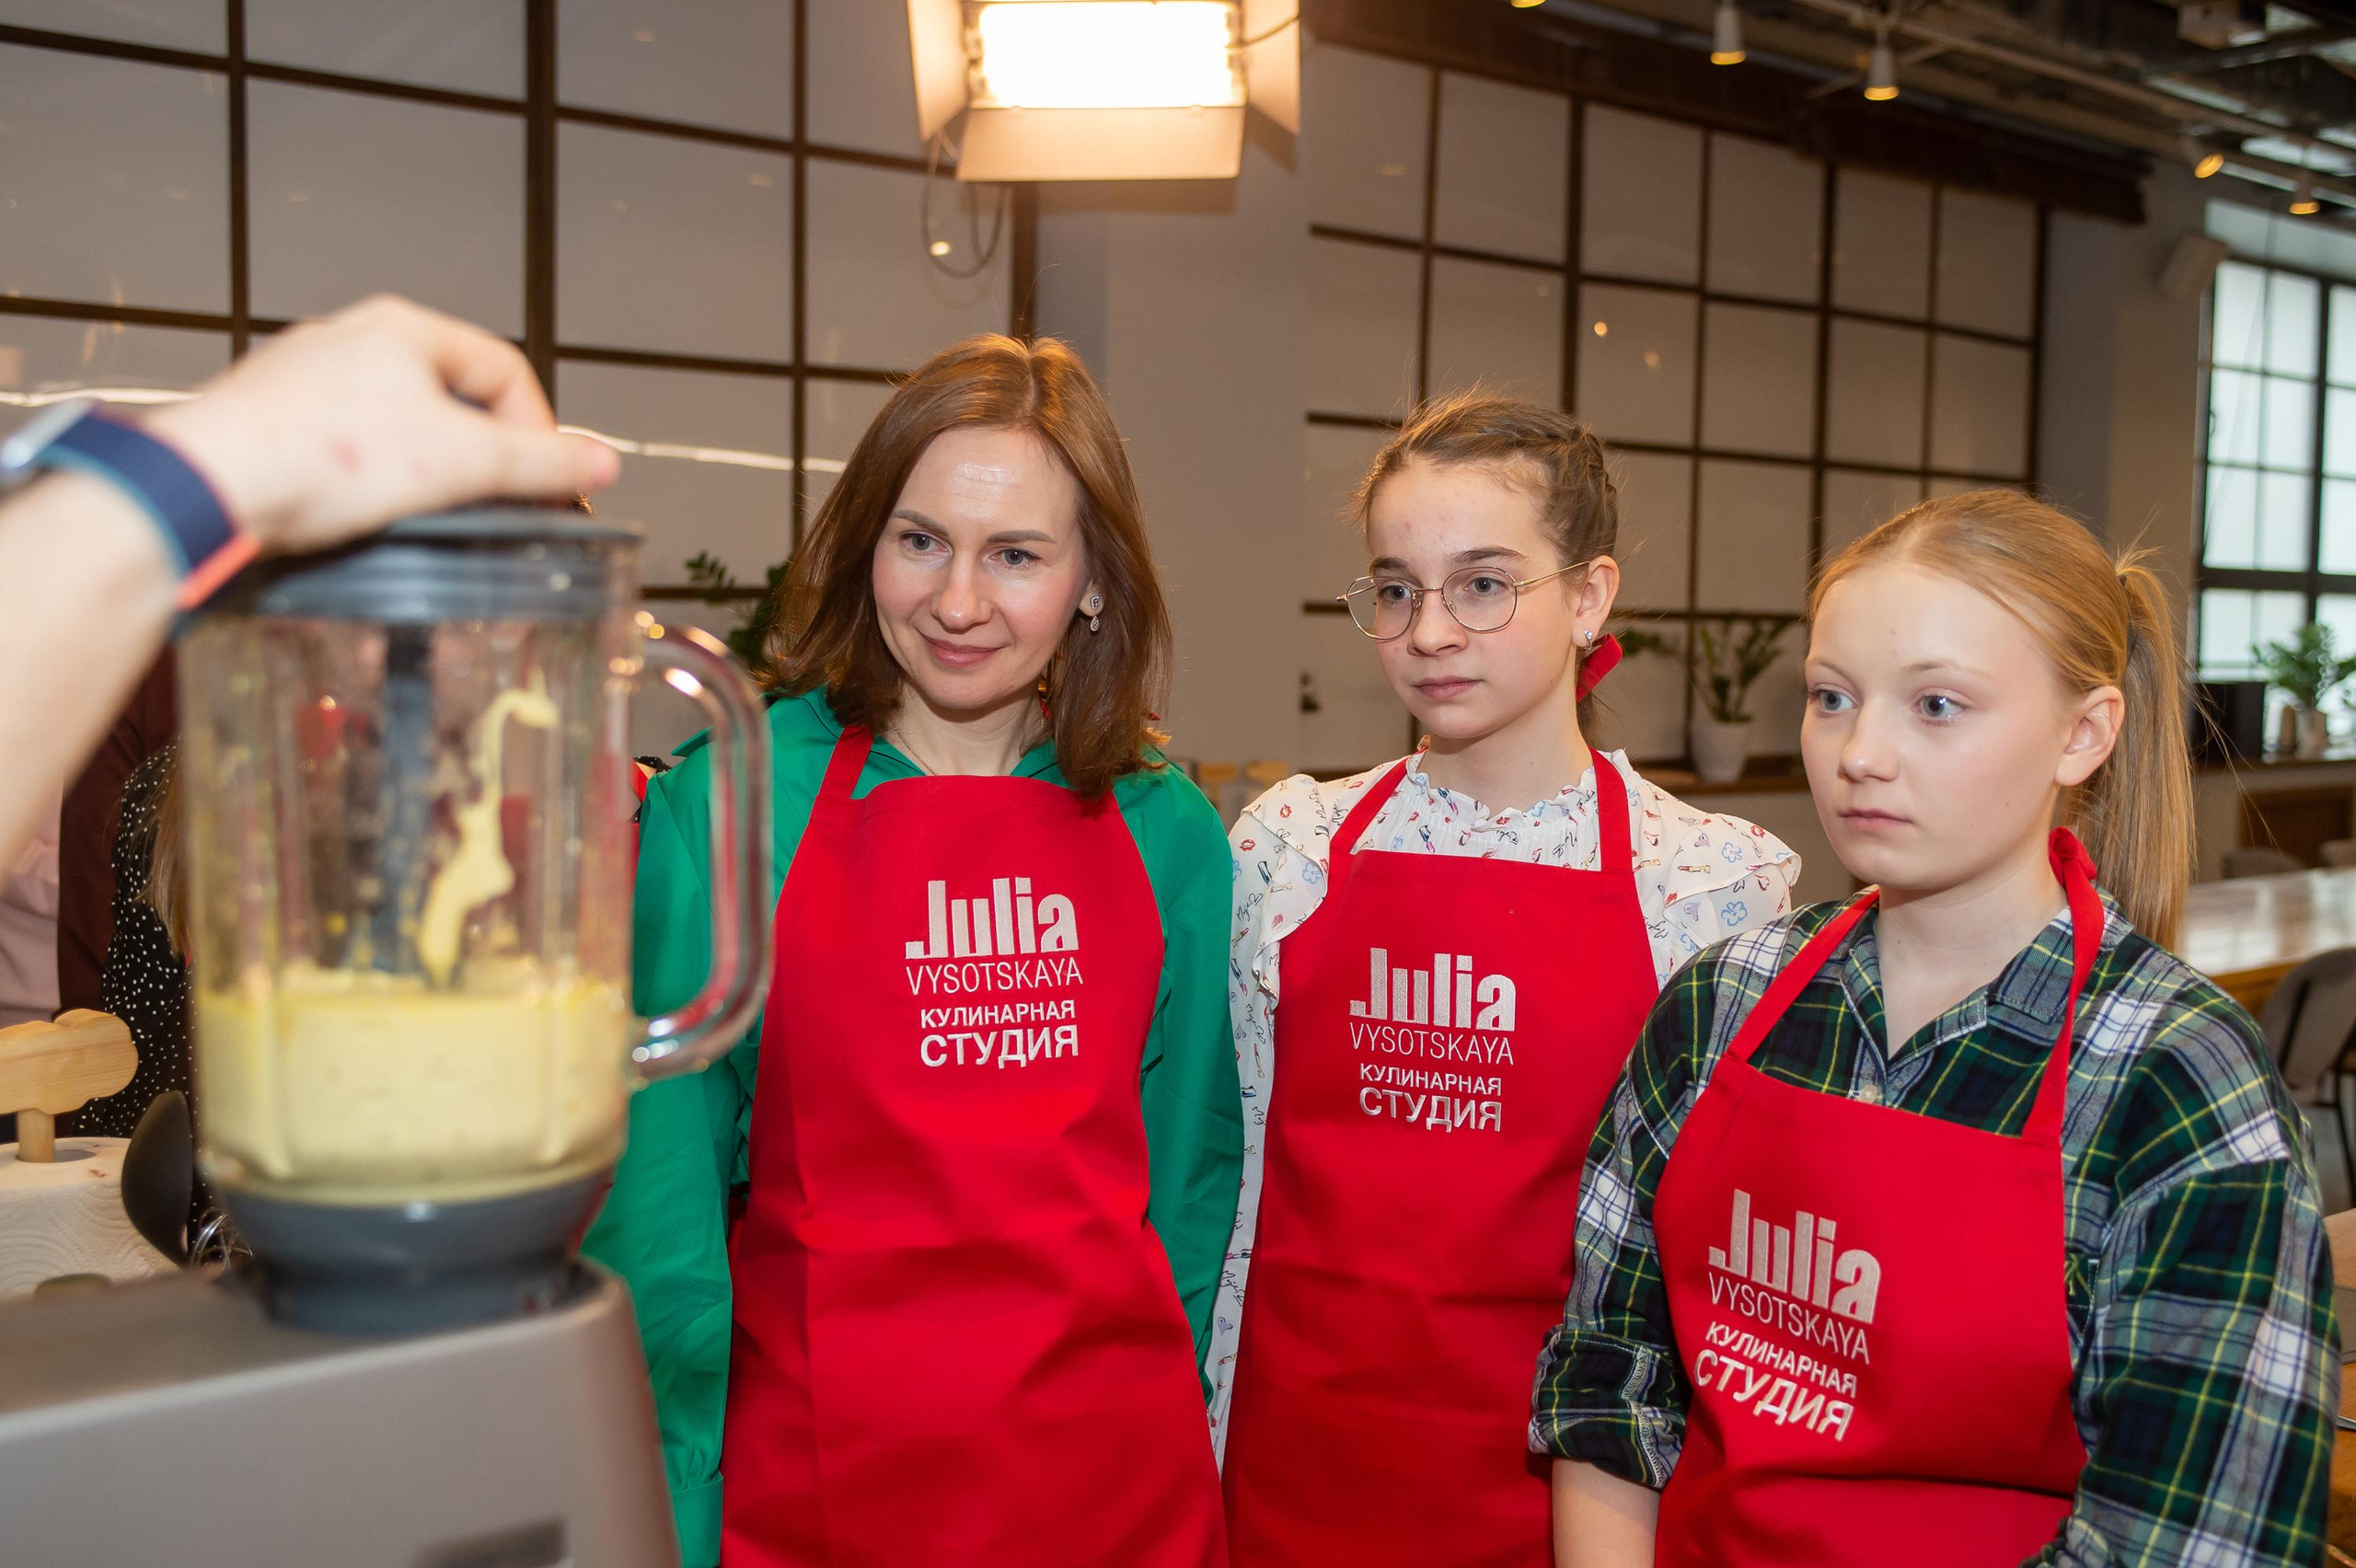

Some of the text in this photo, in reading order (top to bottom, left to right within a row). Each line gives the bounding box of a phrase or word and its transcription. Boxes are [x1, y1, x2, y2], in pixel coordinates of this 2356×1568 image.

[905, 876, 1080, 959] Julia
[906, 956, 1084, 996] VYSOTSKAYA
[1349, 947, 1517, 1032] Julia
[920, 999, 1076, 1029] КУЛИНАРНАЯ
[1349, 1021, 1514, 1066] VYSOTSKAYA
[920, 1024, 1079, 1069] СТУДИЯ
[1359, 1063, 1502, 1096] КУЛИНАРНАЯ
[1359, 1087, 1502, 1133] СТУДИЯ
[1708, 1188, 1881, 1325] Julia
[1708, 1272, 1870, 1365] VYSOTSKAYA
[1705, 1320, 1857, 1399] КУЛИНАРНАЯ
[1694, 1349, 1854, 1441] СТУДИЯ
